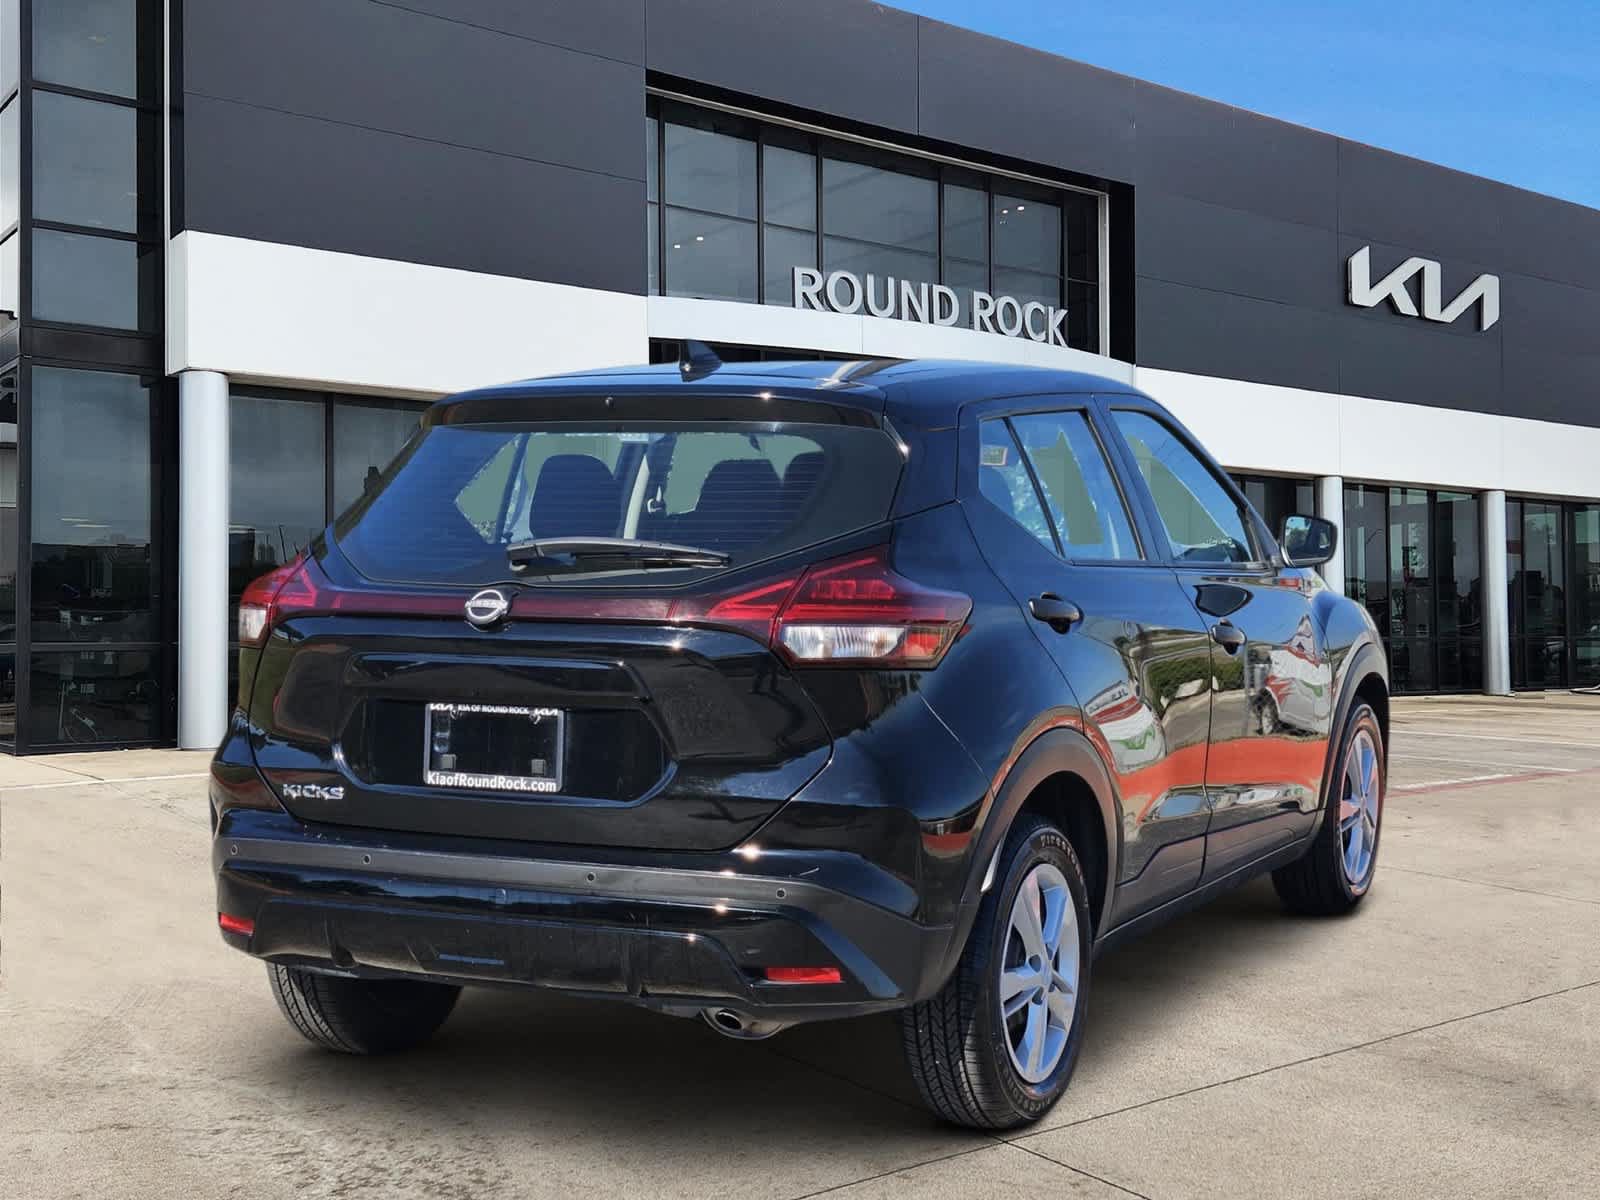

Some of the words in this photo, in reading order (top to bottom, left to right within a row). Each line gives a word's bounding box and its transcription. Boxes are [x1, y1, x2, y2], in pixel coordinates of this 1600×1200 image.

[1348, 246, 1499, 331] KIA
[793, 266, 960, 327] ROUND
[972, 289, 1068, 348] ROCK
[457, 704, 470, 712] KIA
[471, 704, 480, 712] OF
[482, 705, 508, 713] ROUND
[509, 706, 529, 714] ROCK
[283, 784, 344, 800] KICKS
[427, 771, 557, 792] KiaofRoundRock.com
